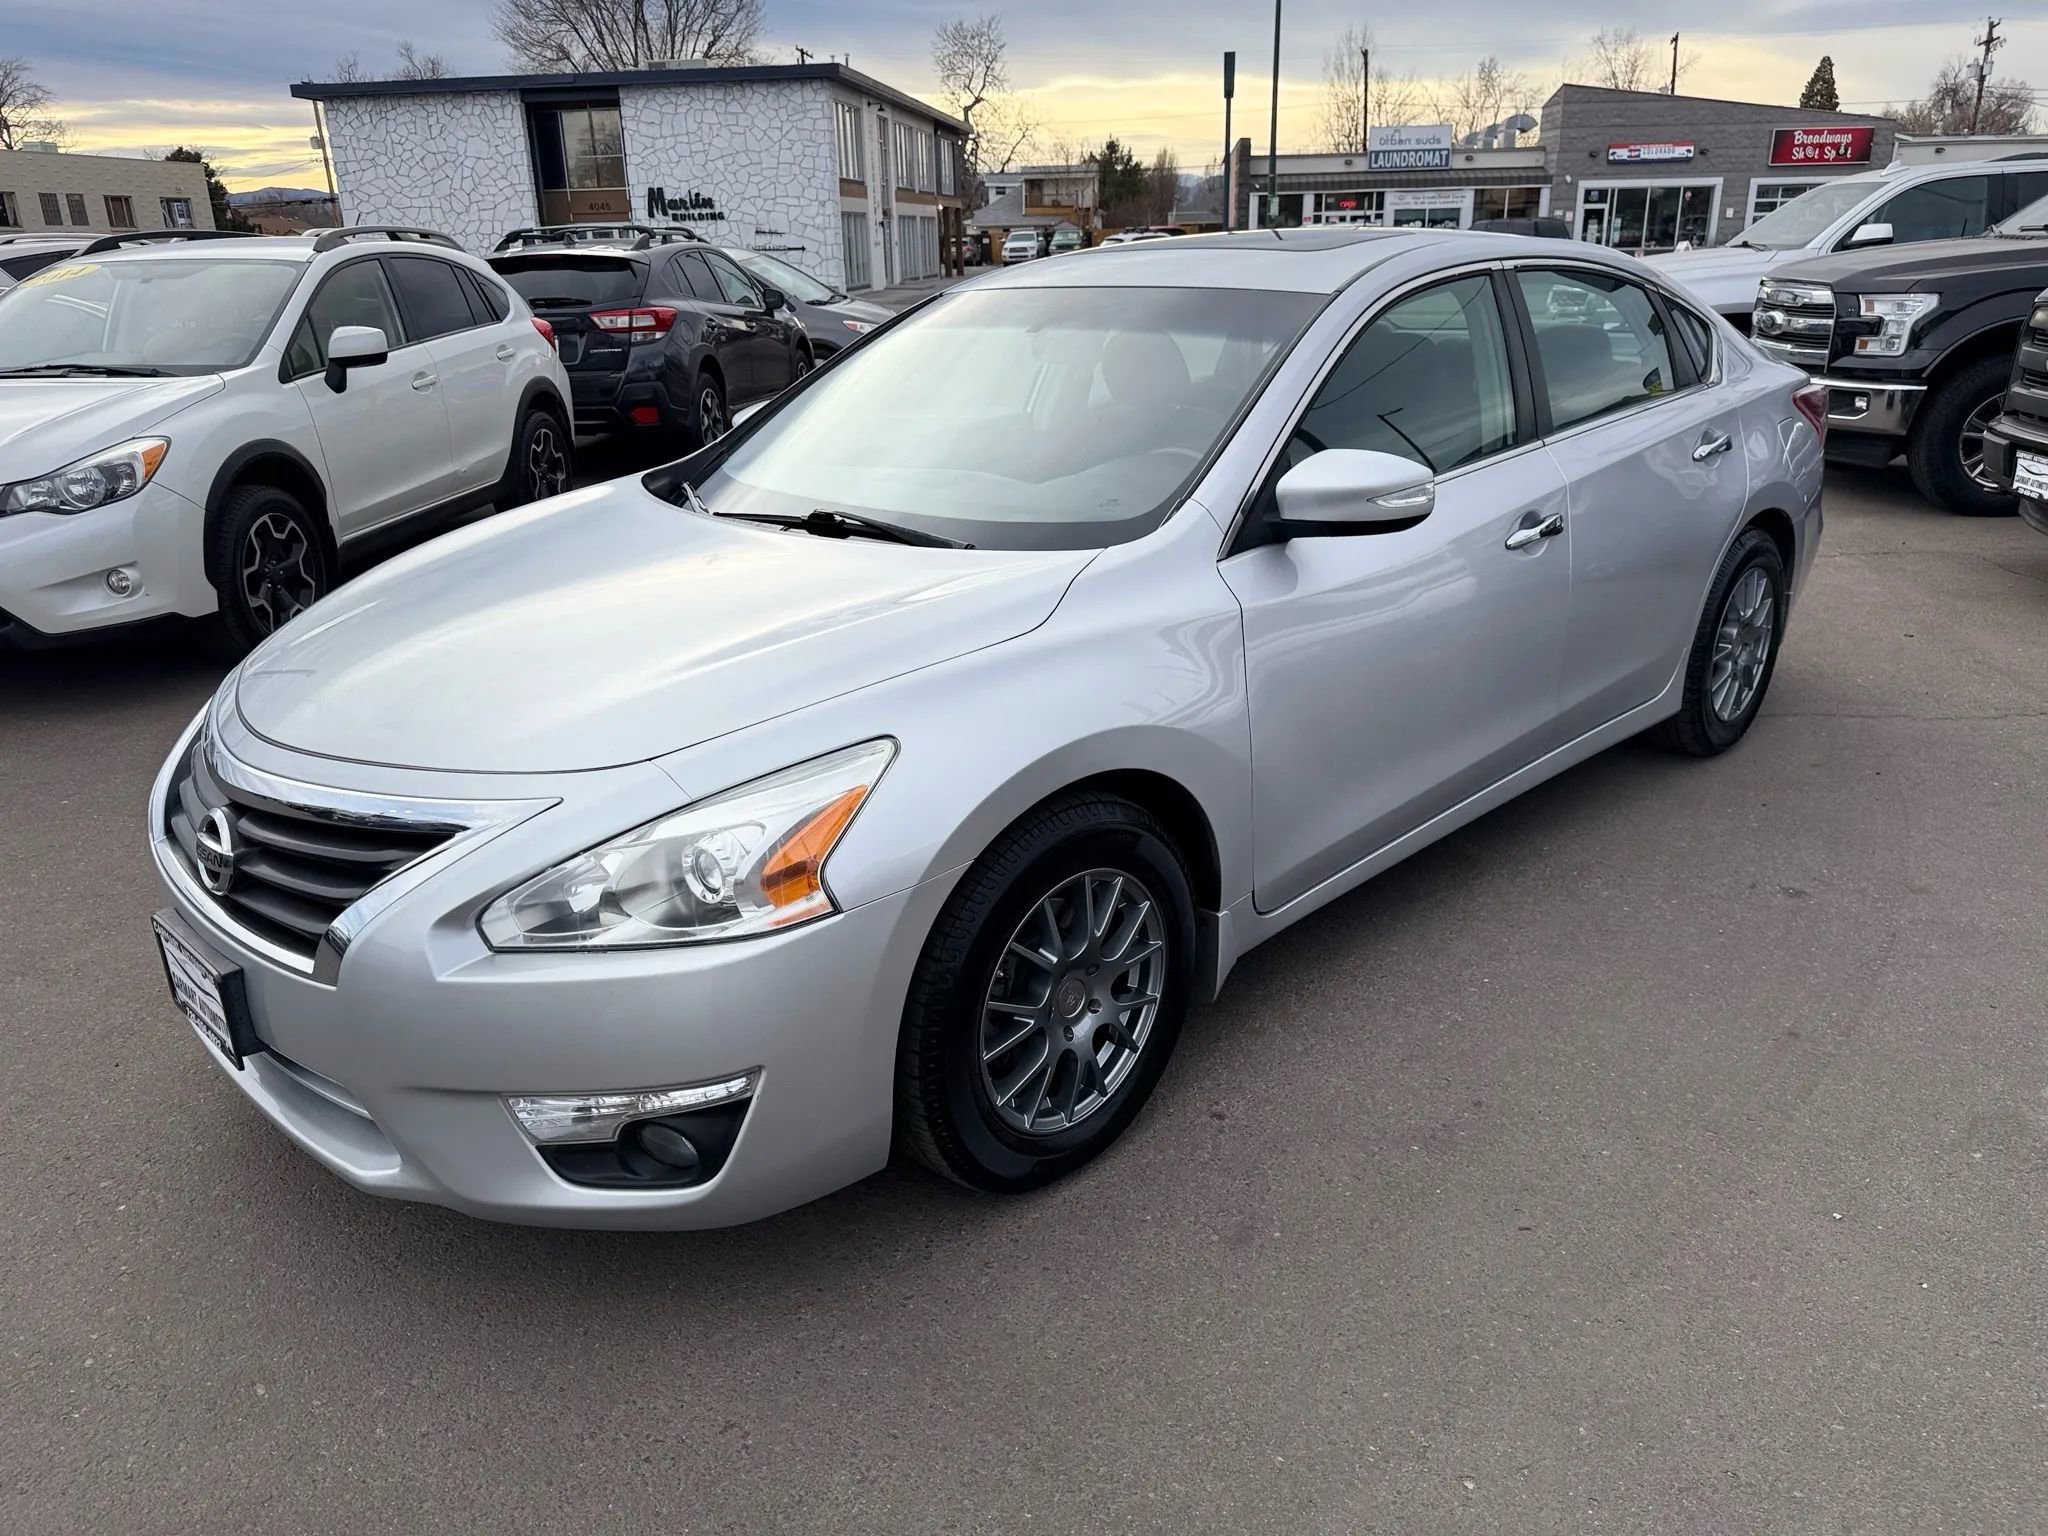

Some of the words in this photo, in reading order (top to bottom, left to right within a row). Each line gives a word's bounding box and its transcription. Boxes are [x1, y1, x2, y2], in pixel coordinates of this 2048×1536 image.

[1793, 130, 1853, 145] Broadways
[1371, 150, 1448, 168] LAUNDROMAT
[588, 202, 612, 211] 4045
[647, 187, 715, 218] Marlin
[1340, 200, 1357, 209] OPEN
[671, 211, 726, 222] BUILDING
